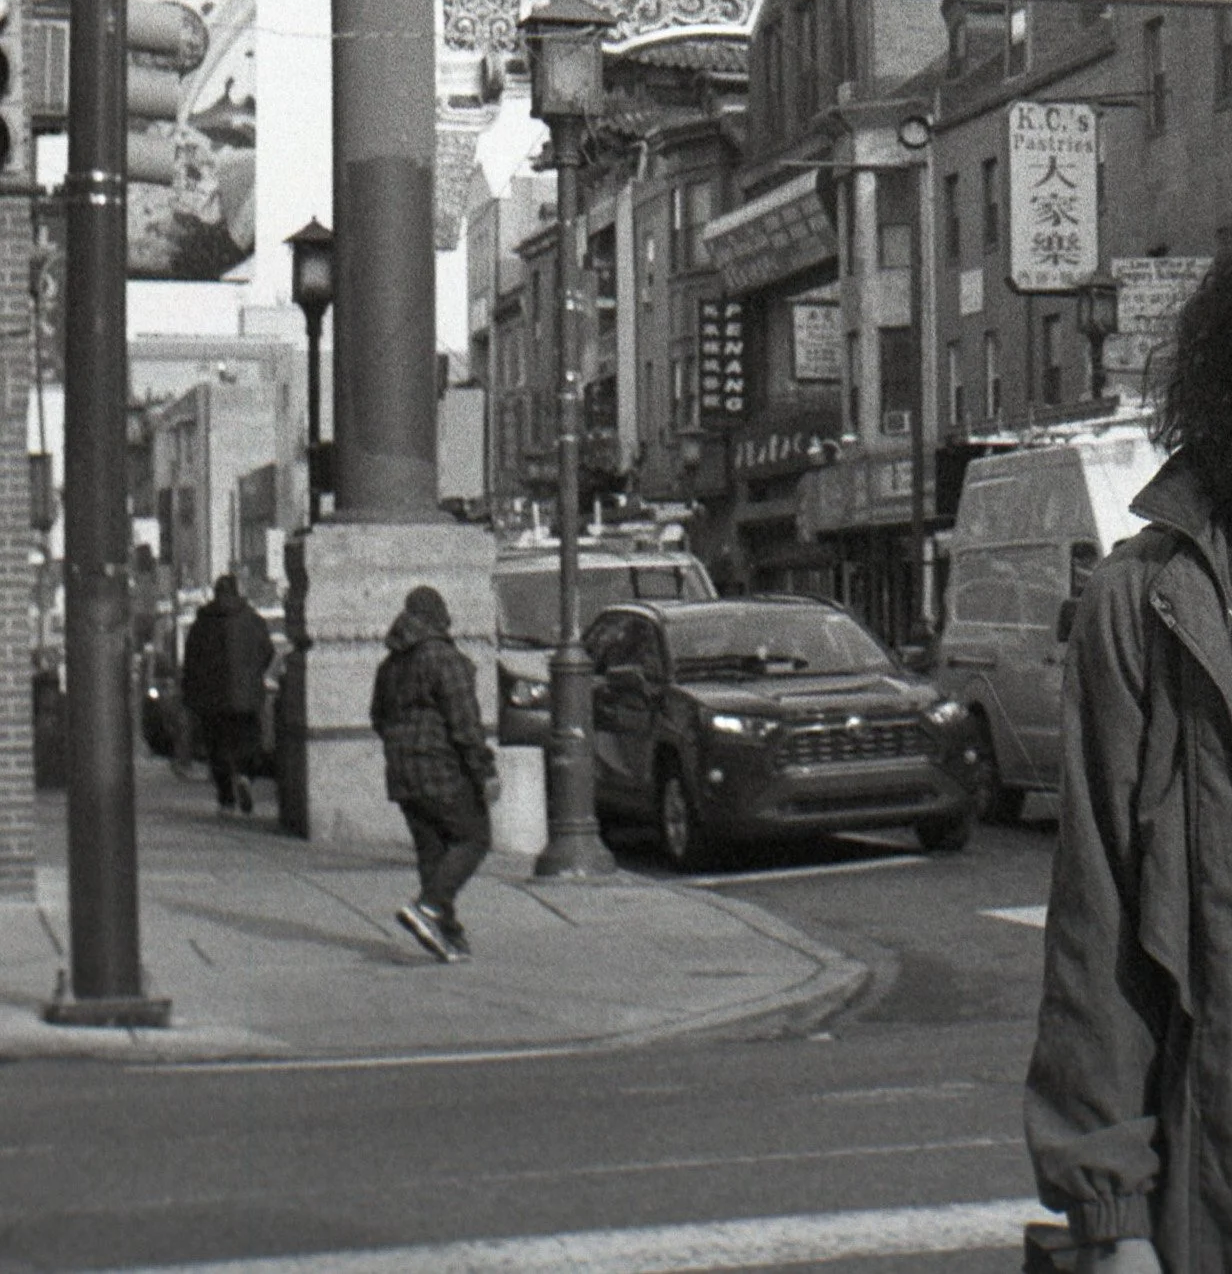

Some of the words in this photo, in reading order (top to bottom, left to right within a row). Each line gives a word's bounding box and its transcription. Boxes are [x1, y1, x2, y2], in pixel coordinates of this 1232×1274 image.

[1016, 106, 1090, 133] K.C.'s
[1012, 133, 1094, 154] Pastries
[1028, 155, 1082, 266] 大家樂
